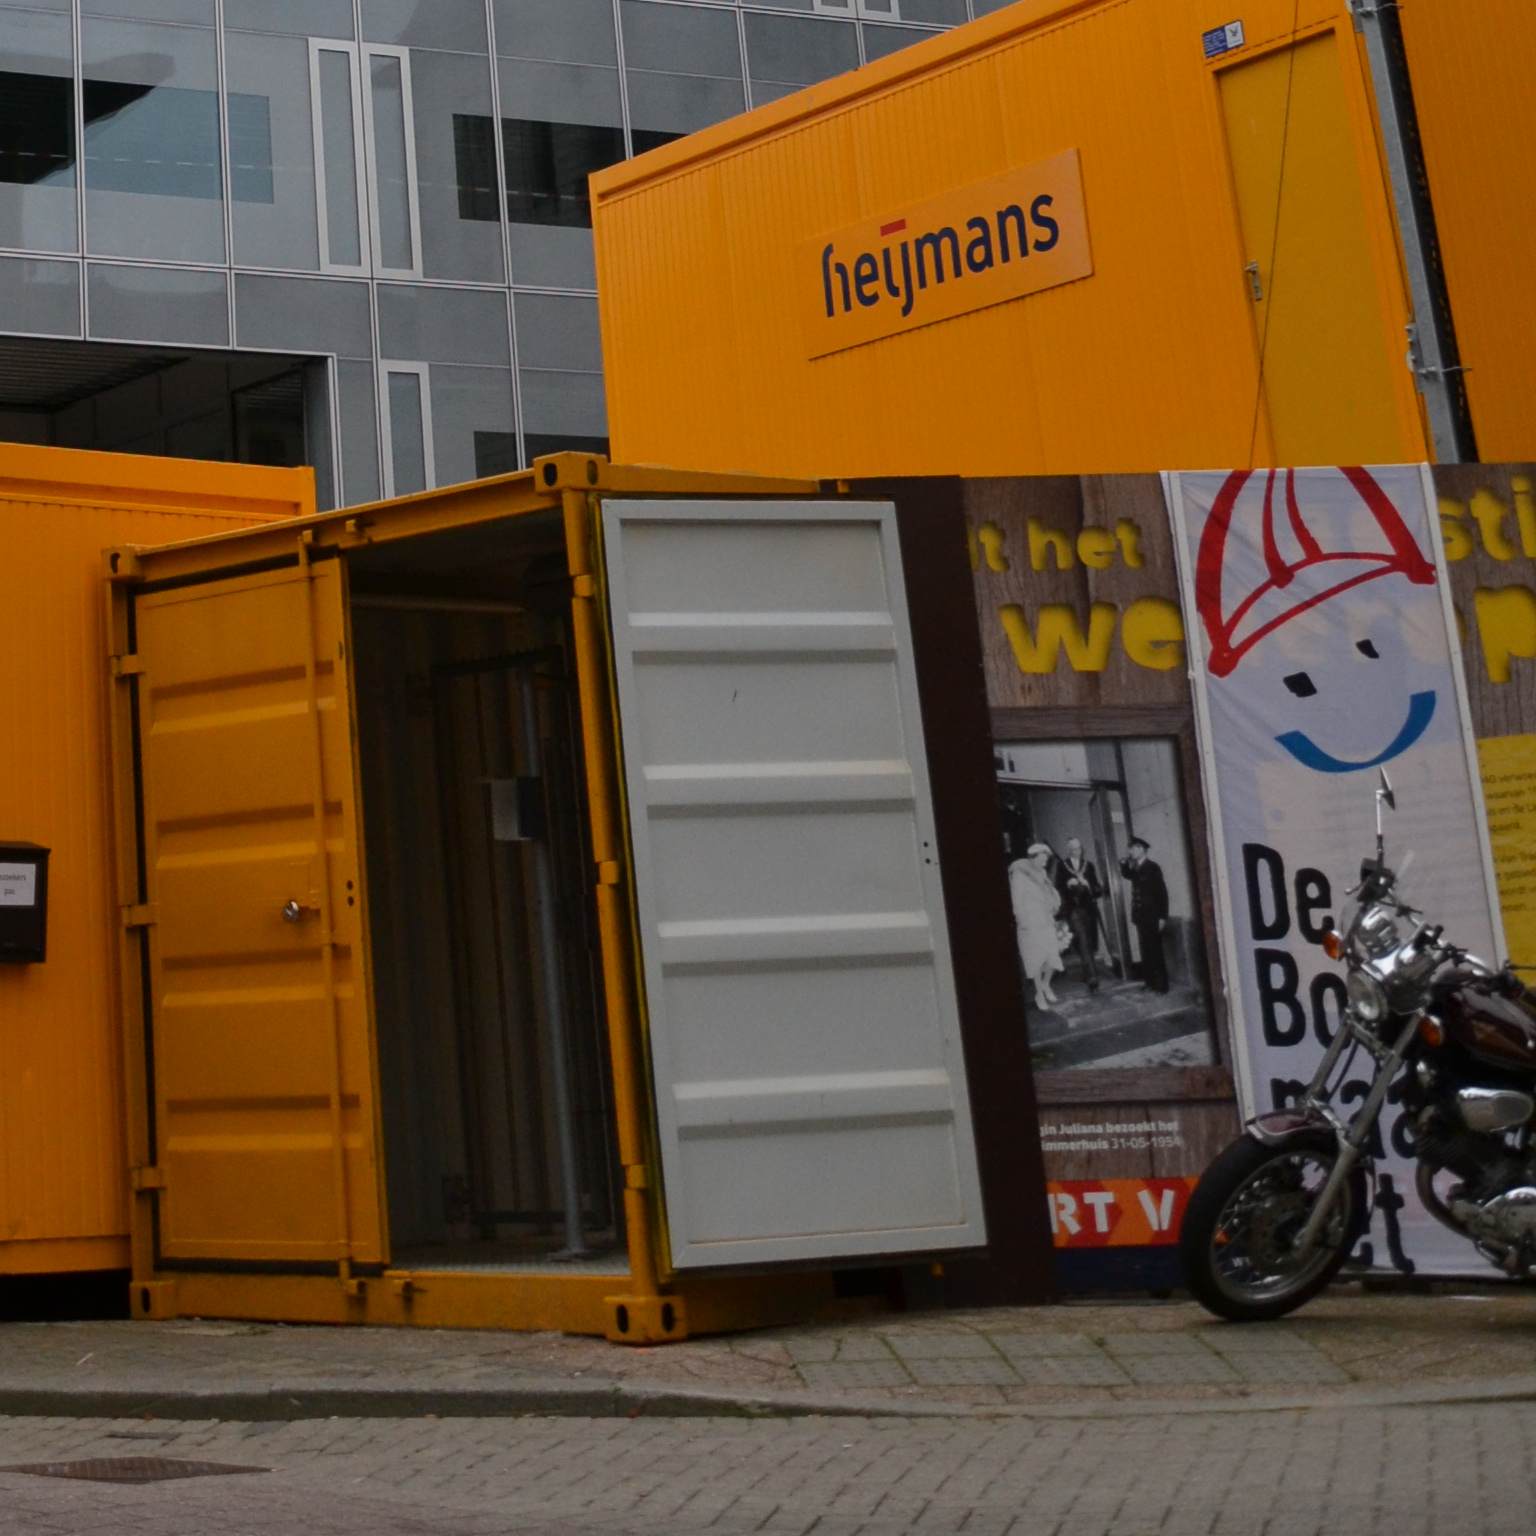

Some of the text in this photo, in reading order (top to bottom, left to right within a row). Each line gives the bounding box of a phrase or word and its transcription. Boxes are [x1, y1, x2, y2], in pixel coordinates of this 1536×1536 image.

[821, 193, 1060, 319] heijmans
[1027, 514, 1145, 571] het
[1242, 842, 1335, 945] De
[1060, 1121, 1104, 1135] Juliana
[1105, 1120, 1156, 1133] bezoekt
[1158, 1119, 1179, 1132] het
[1111, 1135, 1182, 1149] 31-05-1954
